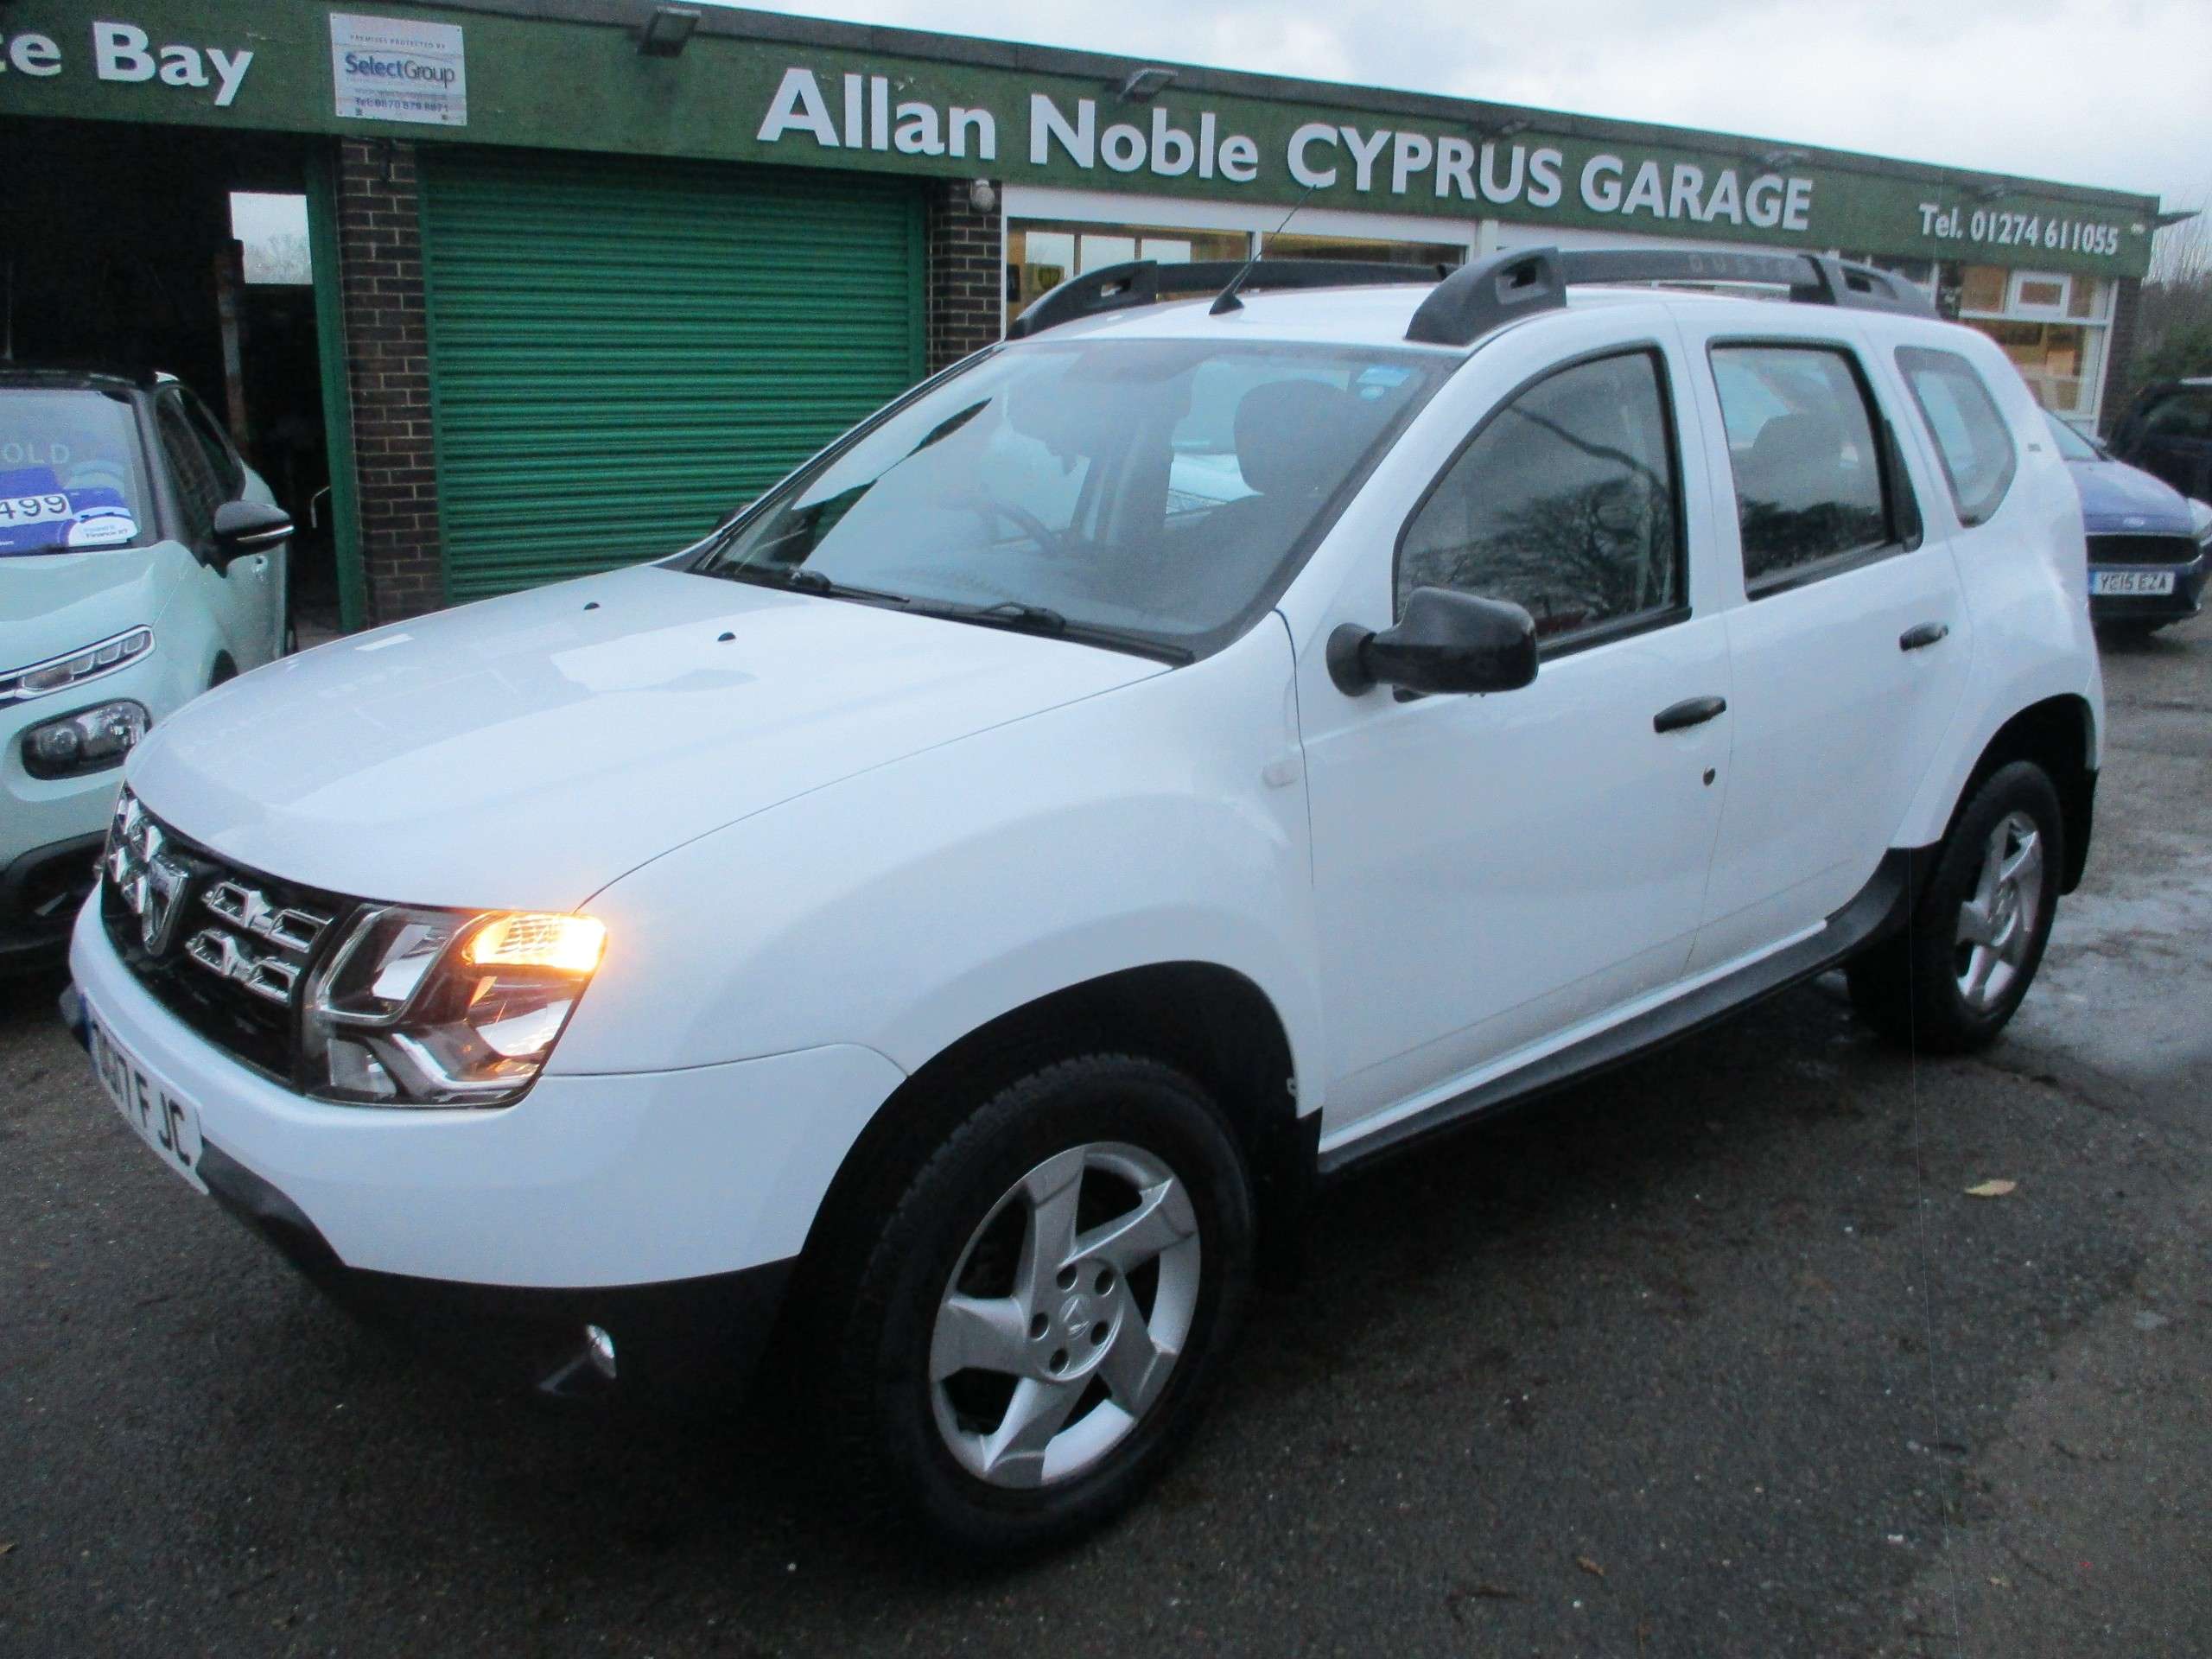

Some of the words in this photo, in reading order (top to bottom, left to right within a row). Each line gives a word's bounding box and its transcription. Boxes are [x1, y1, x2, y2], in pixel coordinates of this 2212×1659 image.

[92, 21, 254, 107] Bay
[345, 51, 455, 89] SelectGroup
[757, 67, 996, 161] Allan
[1031, 93, 1259, 183] Noble
[1287, 123, 1563, 209] CYPRUS
[1580, 154, 1814, 231] GARAGE
[1919, 203, 1963, 239] Tel.
[1970, 209, 2037, 247] 01274
[2044, 219, 2119, 256] 611055
[2, 442, 70, 464] OLD
[0, 495, 67, 520] 499
